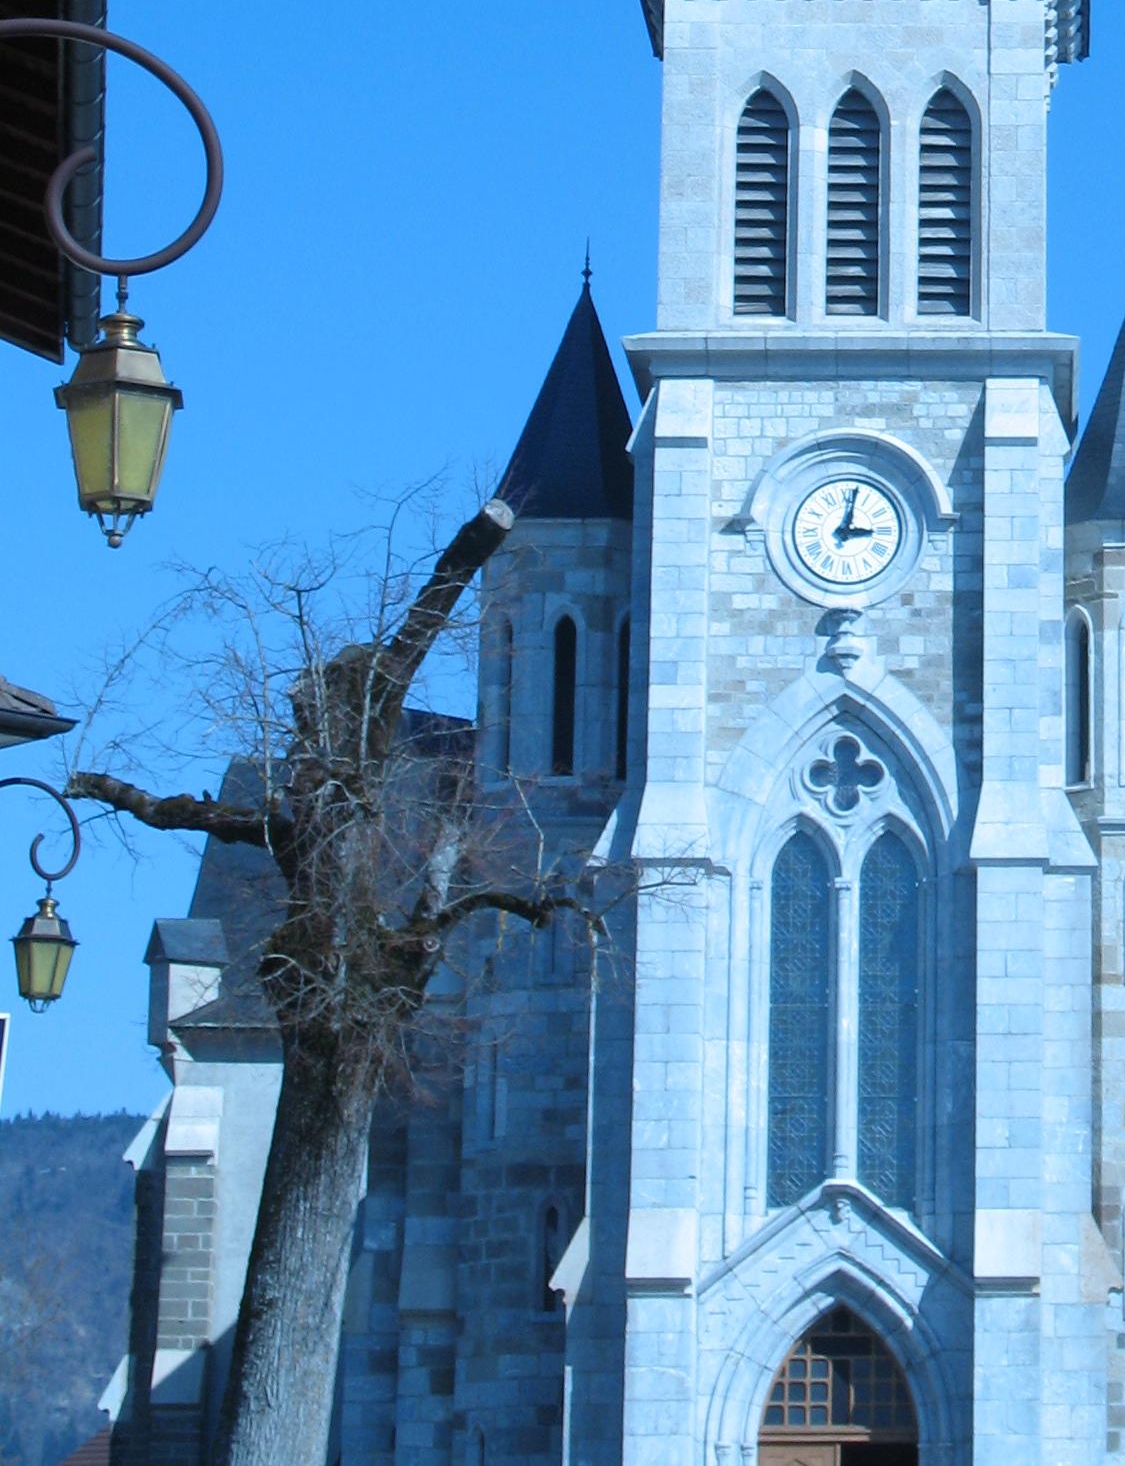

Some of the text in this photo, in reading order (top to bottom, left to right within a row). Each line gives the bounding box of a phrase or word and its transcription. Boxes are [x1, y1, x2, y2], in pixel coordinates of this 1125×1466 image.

[822, 493, 837, 507] XI
[807, 509, 823, 519] X
[872, 508, 887, 519] II
[803, 527, 818, 537] IX
[877, 527, 892, 536] III
[842, 560, 852, 575] VI
